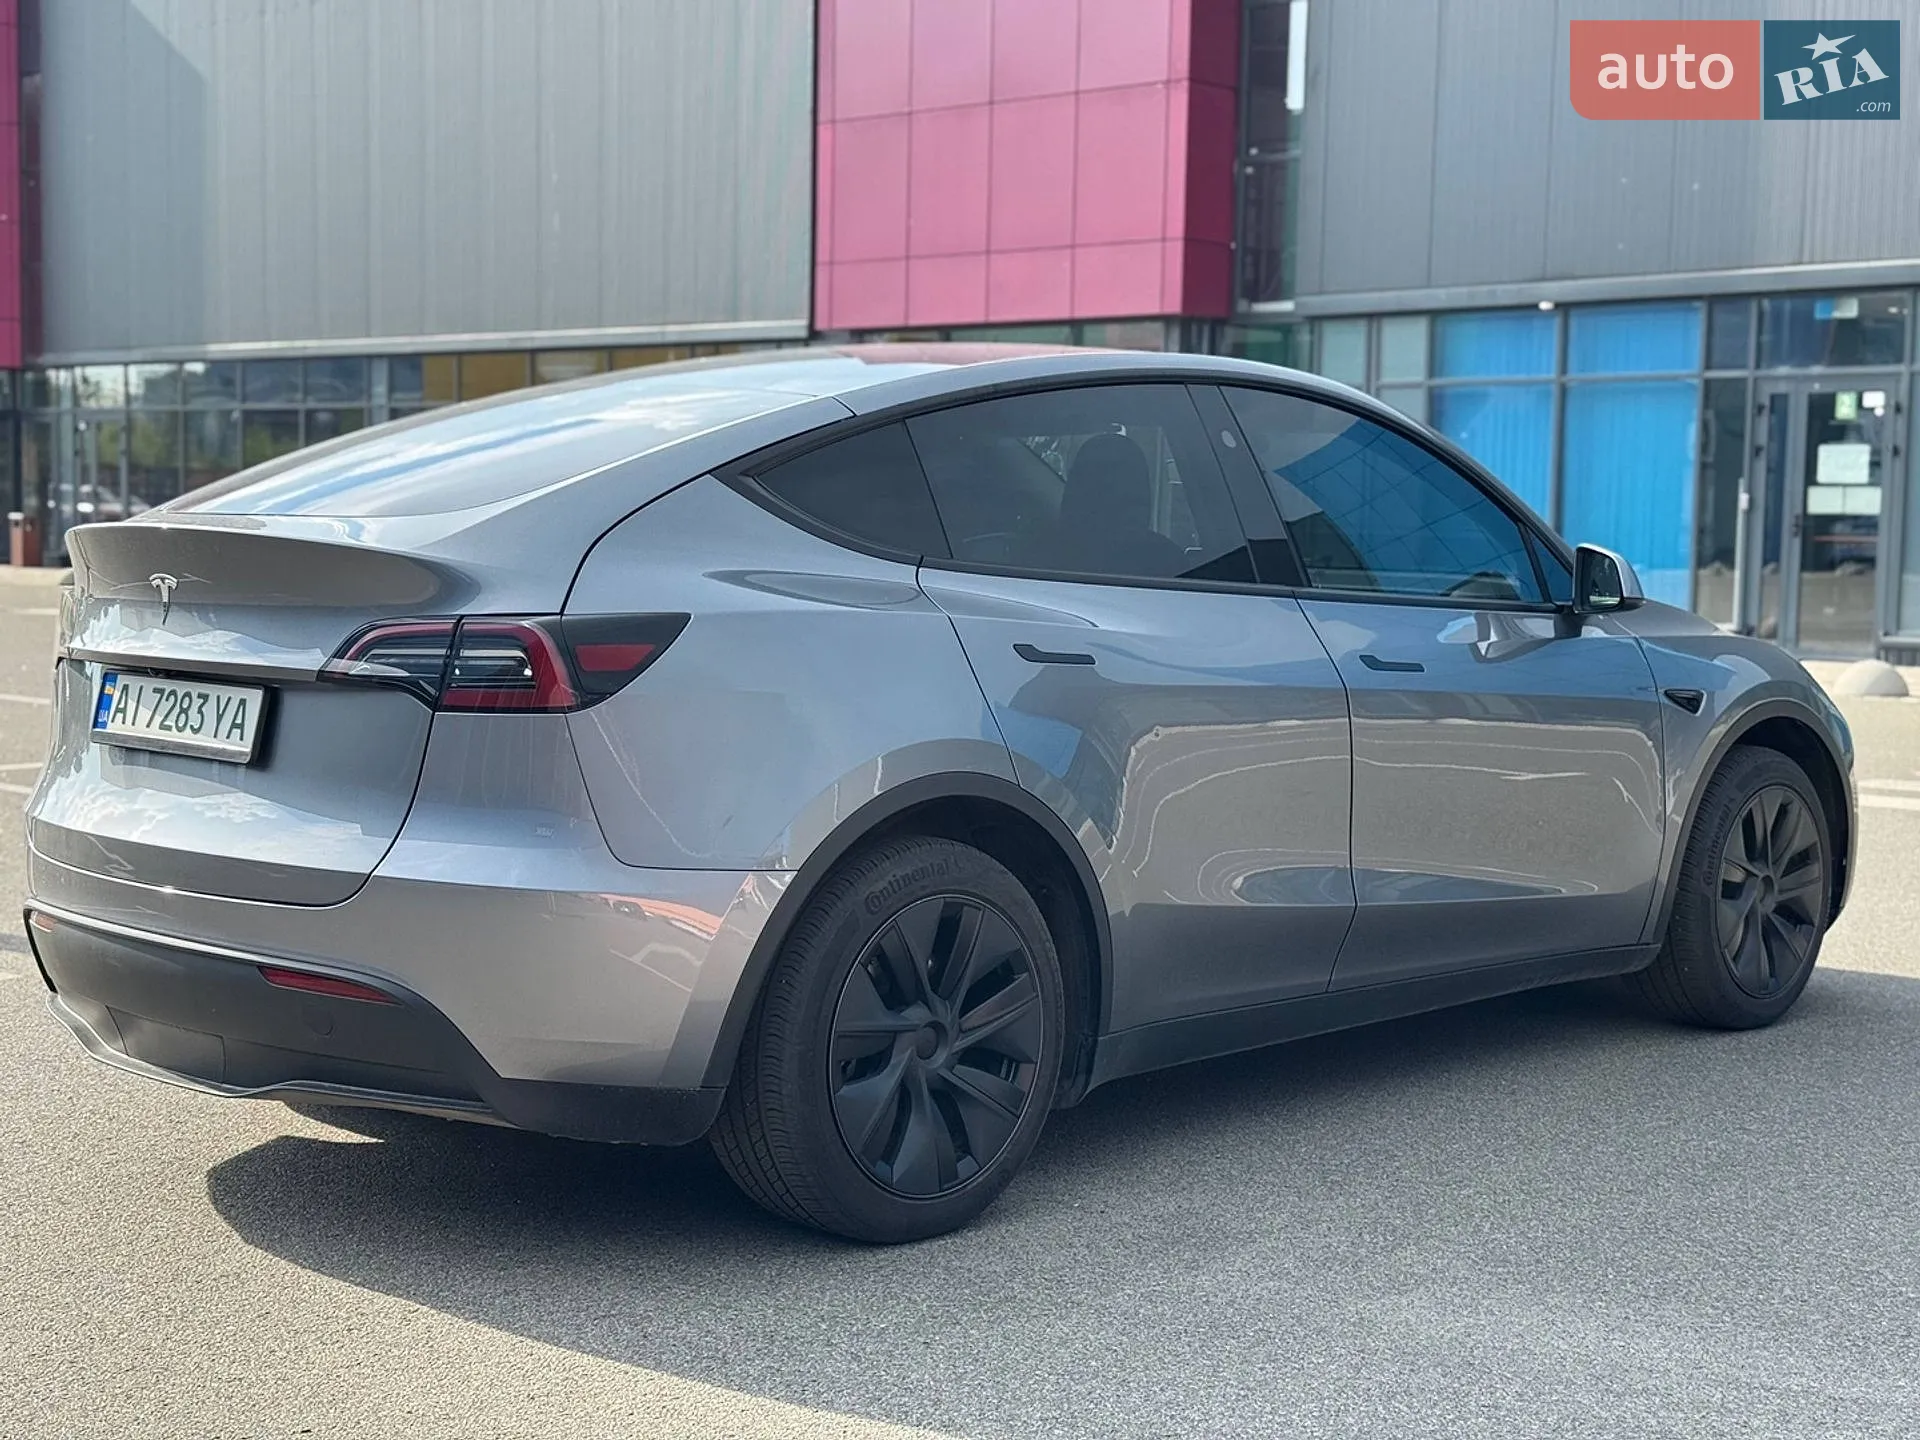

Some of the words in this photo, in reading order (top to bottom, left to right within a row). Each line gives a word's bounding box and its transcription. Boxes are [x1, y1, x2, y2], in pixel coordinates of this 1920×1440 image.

[111, 684, 144, 726] AI
[146, 687, 210, 735] 7283
[213, 694, 247, 741] YA
[864, 857, 950, 916] Continental
